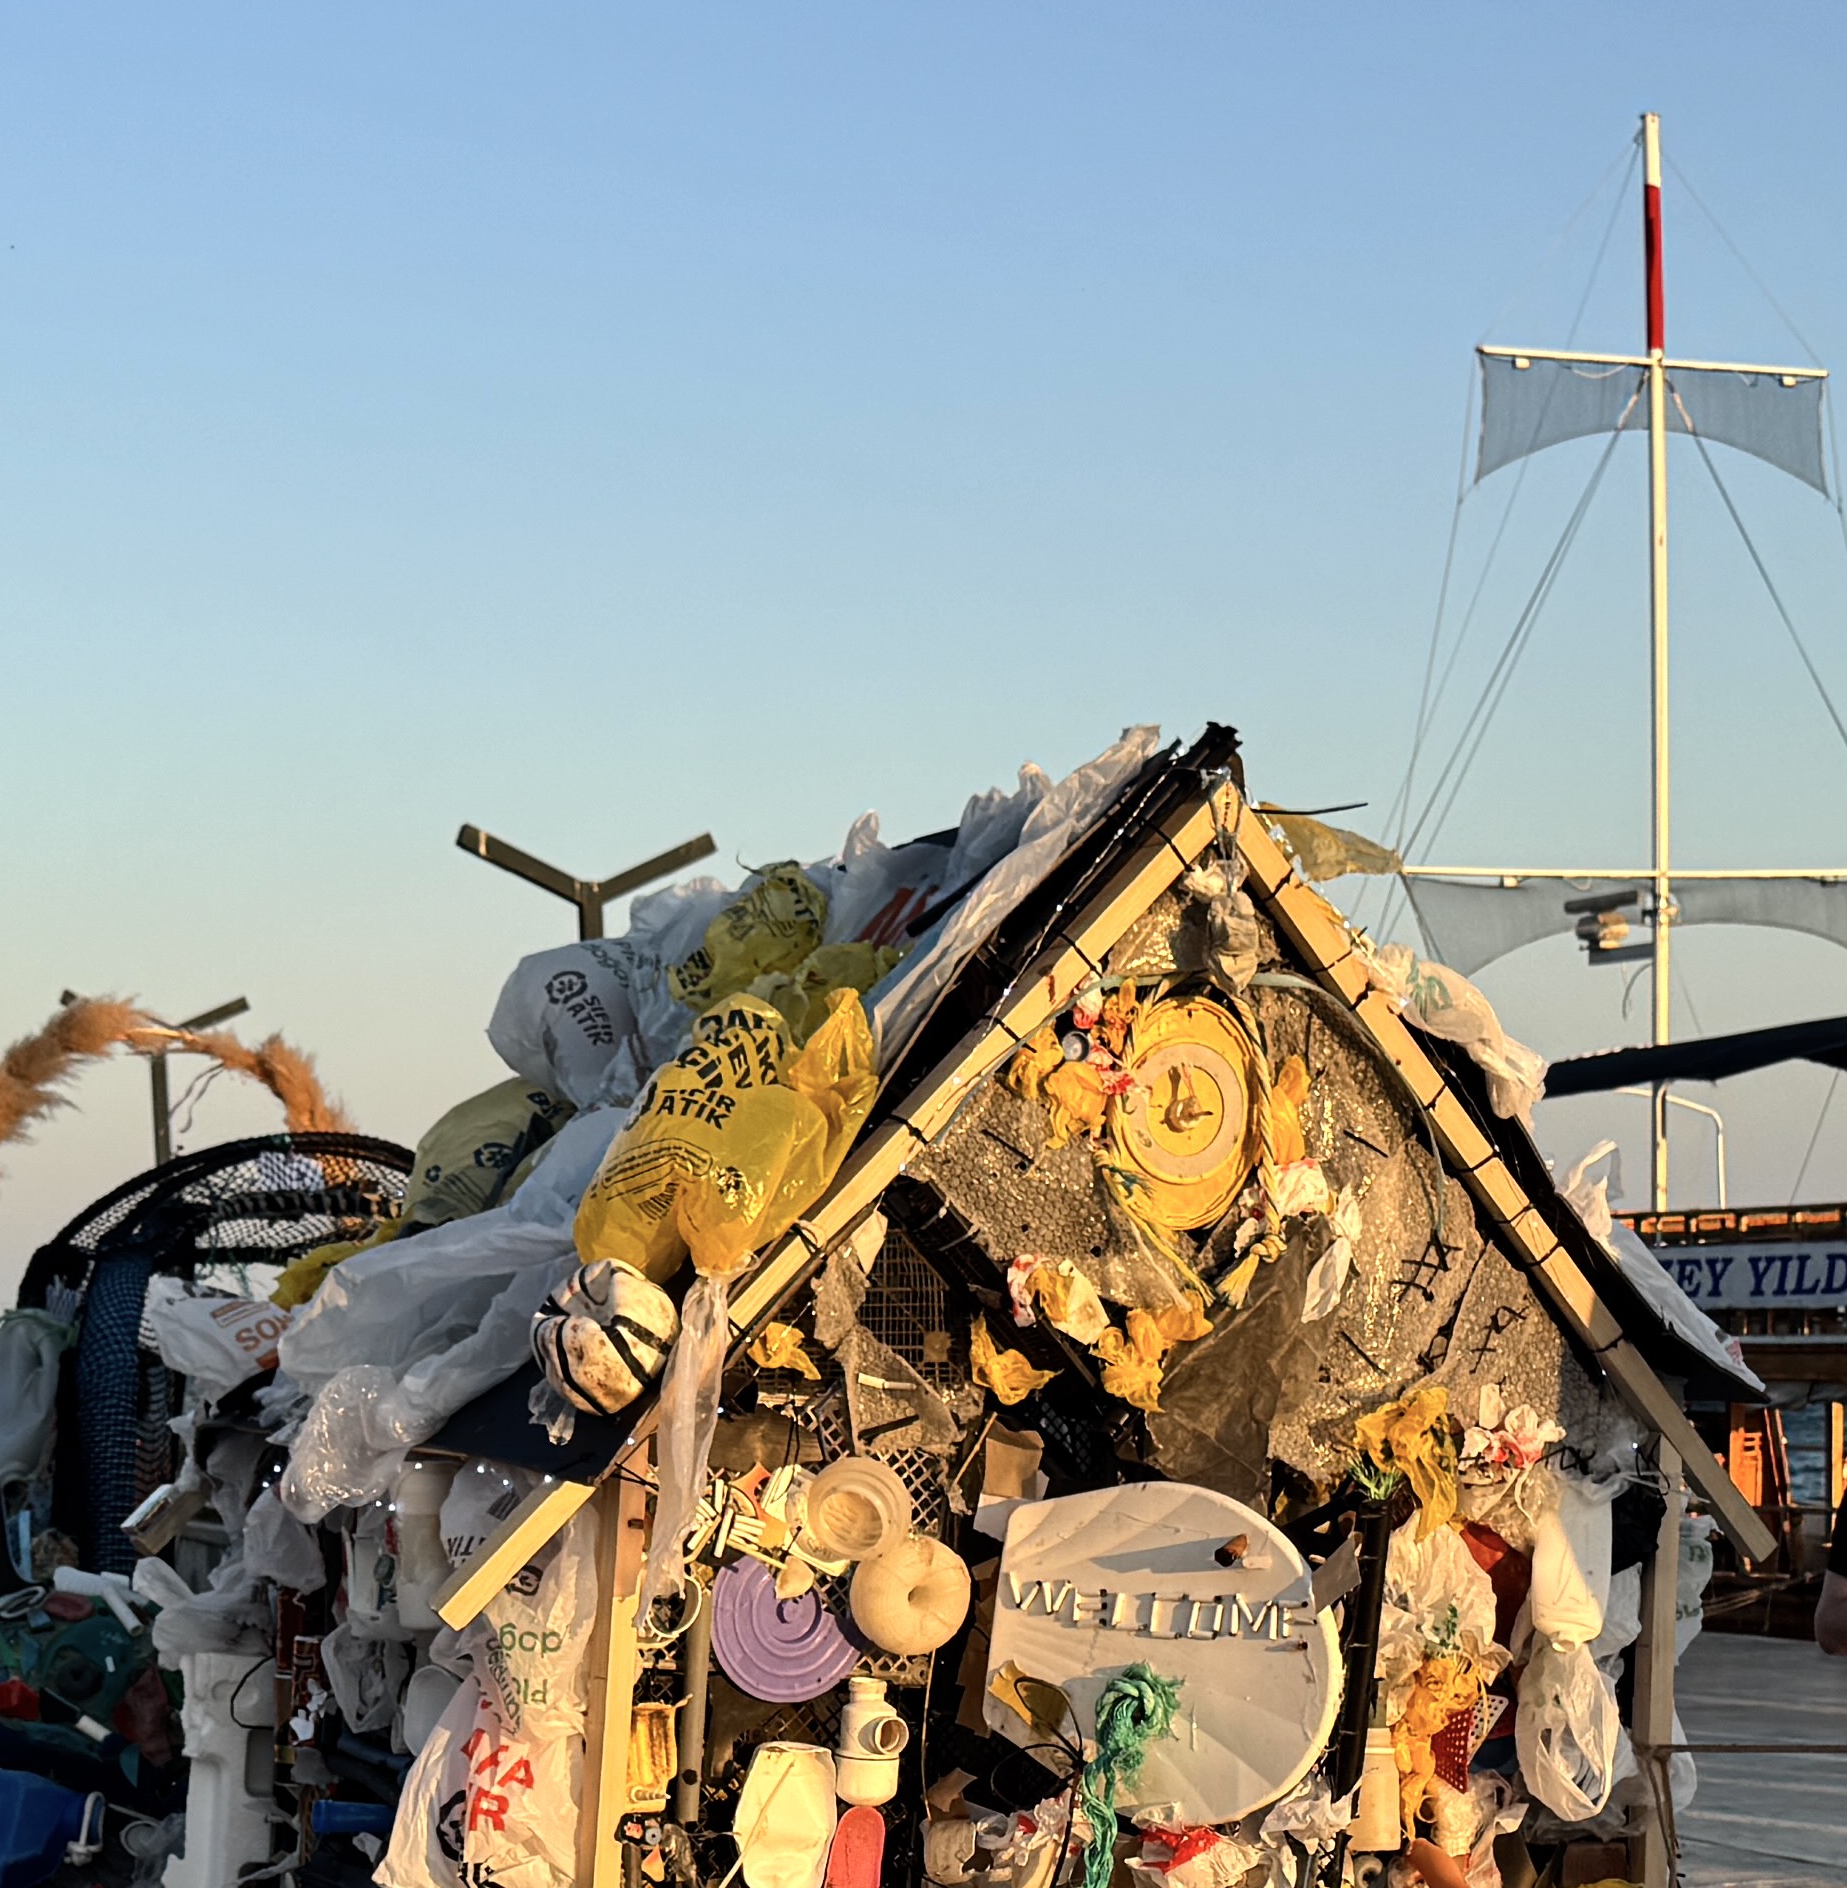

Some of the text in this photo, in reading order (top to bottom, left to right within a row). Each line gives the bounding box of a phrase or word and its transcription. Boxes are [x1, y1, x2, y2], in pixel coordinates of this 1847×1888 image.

[566, 1002, 606, 1047] ATIK
[655, 1094, 731, 1131] ATIK
[1662, 1256, 1734, 1298] EY
[1008, 1570, 1319, 1641] WELCOME
